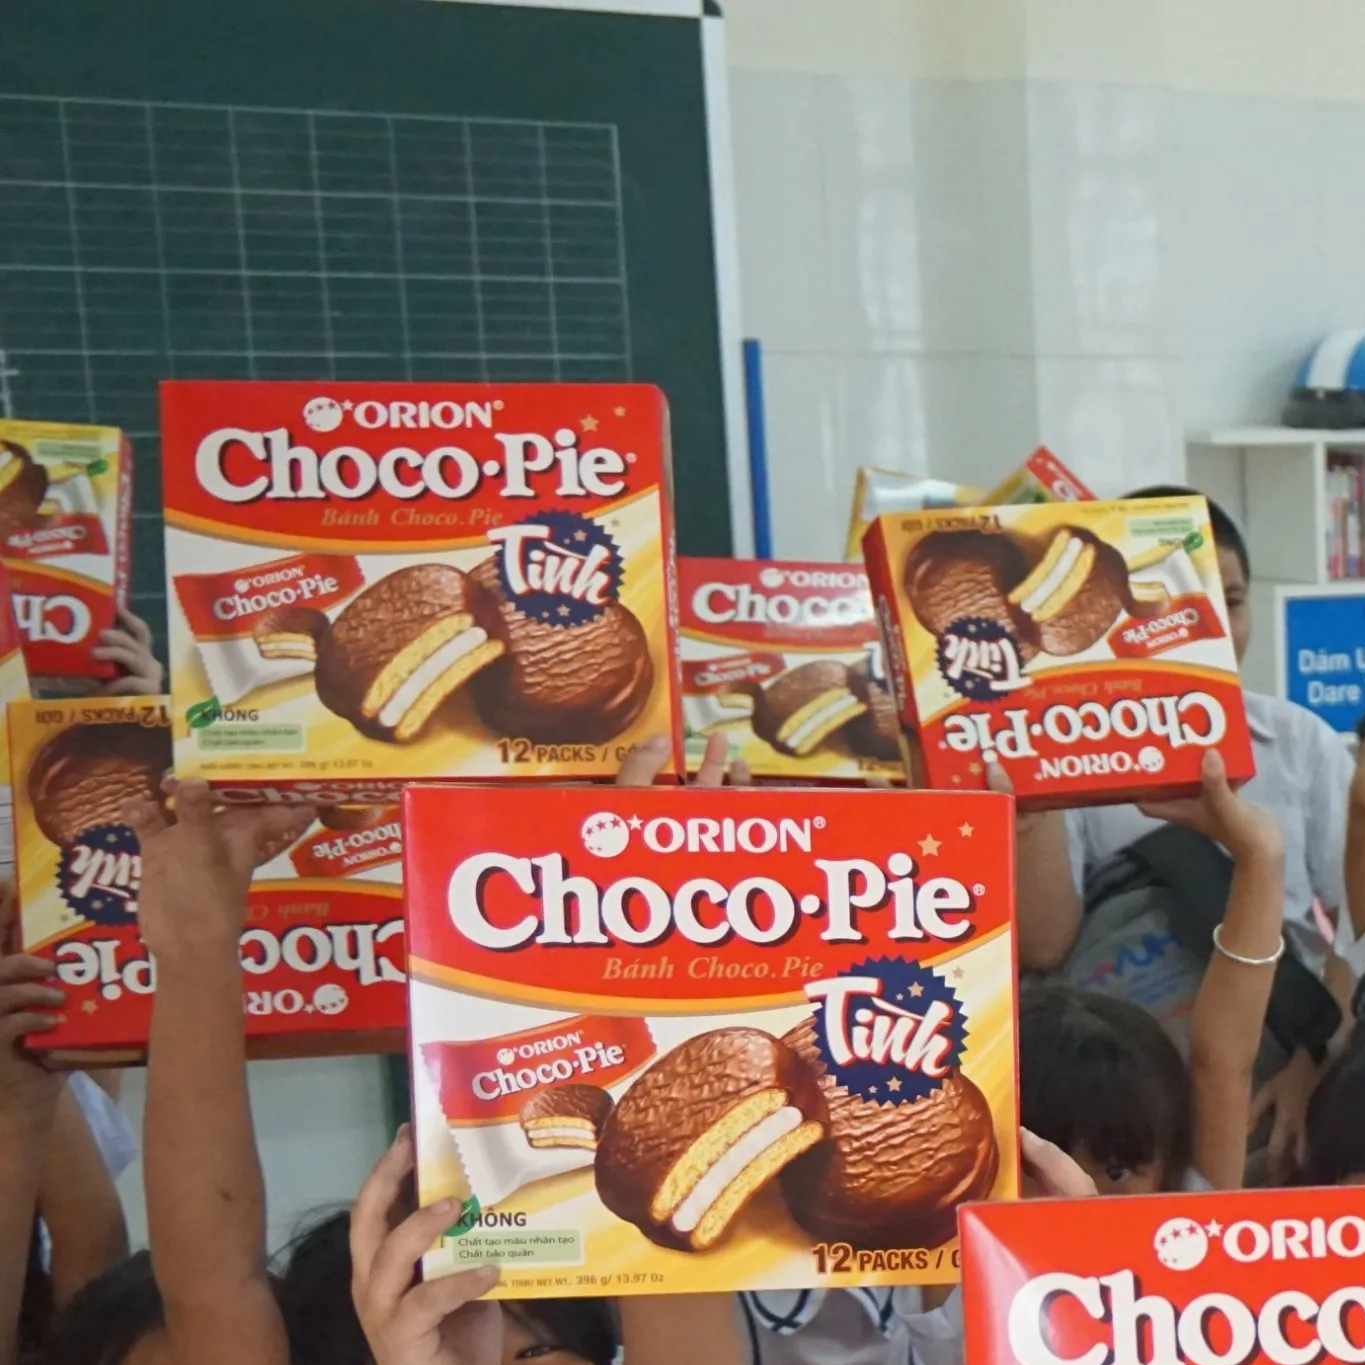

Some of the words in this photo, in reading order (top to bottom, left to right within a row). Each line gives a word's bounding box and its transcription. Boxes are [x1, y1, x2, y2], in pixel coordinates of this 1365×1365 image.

[353, 400, 494, 429] ORION
[194, 427, 628, 502] Choco·Pie
[321, 506, 379, 527] Bánh
[487, 525, 614, 607] Tình
[213, 573, 339, 622] Choco·Pie
[944, 632, 1033, 692] Tình
[1307, 680, 1361, 704] Dare
[943, 691, 1227, 763] Choco·Pie
[498, 739, 532, 764] 12
[537, 743, 596, 763] PACKS
[601, 743, 610, 763] /
[1042, 745, 1130, 778] ORION
[311, 823, 404, 860] hoco·Pie
[643, 815, 812, 854] ORION
[447, 851, 970, 950] Choco·Pie
[602, 955, 674, 981] Bánh
[804, 975, 954, 1077] Tình
[516, 1030, 582, 1060] ORION
[471, 1042, 626, 1101] Choco·Pie
[456, 1208, 527, 1228] KHÔNG
[812, 1242, 857, 1274] 12
[859, 1250, 929, 1272] PACKS
[935, 1250, 944, 1270] /
